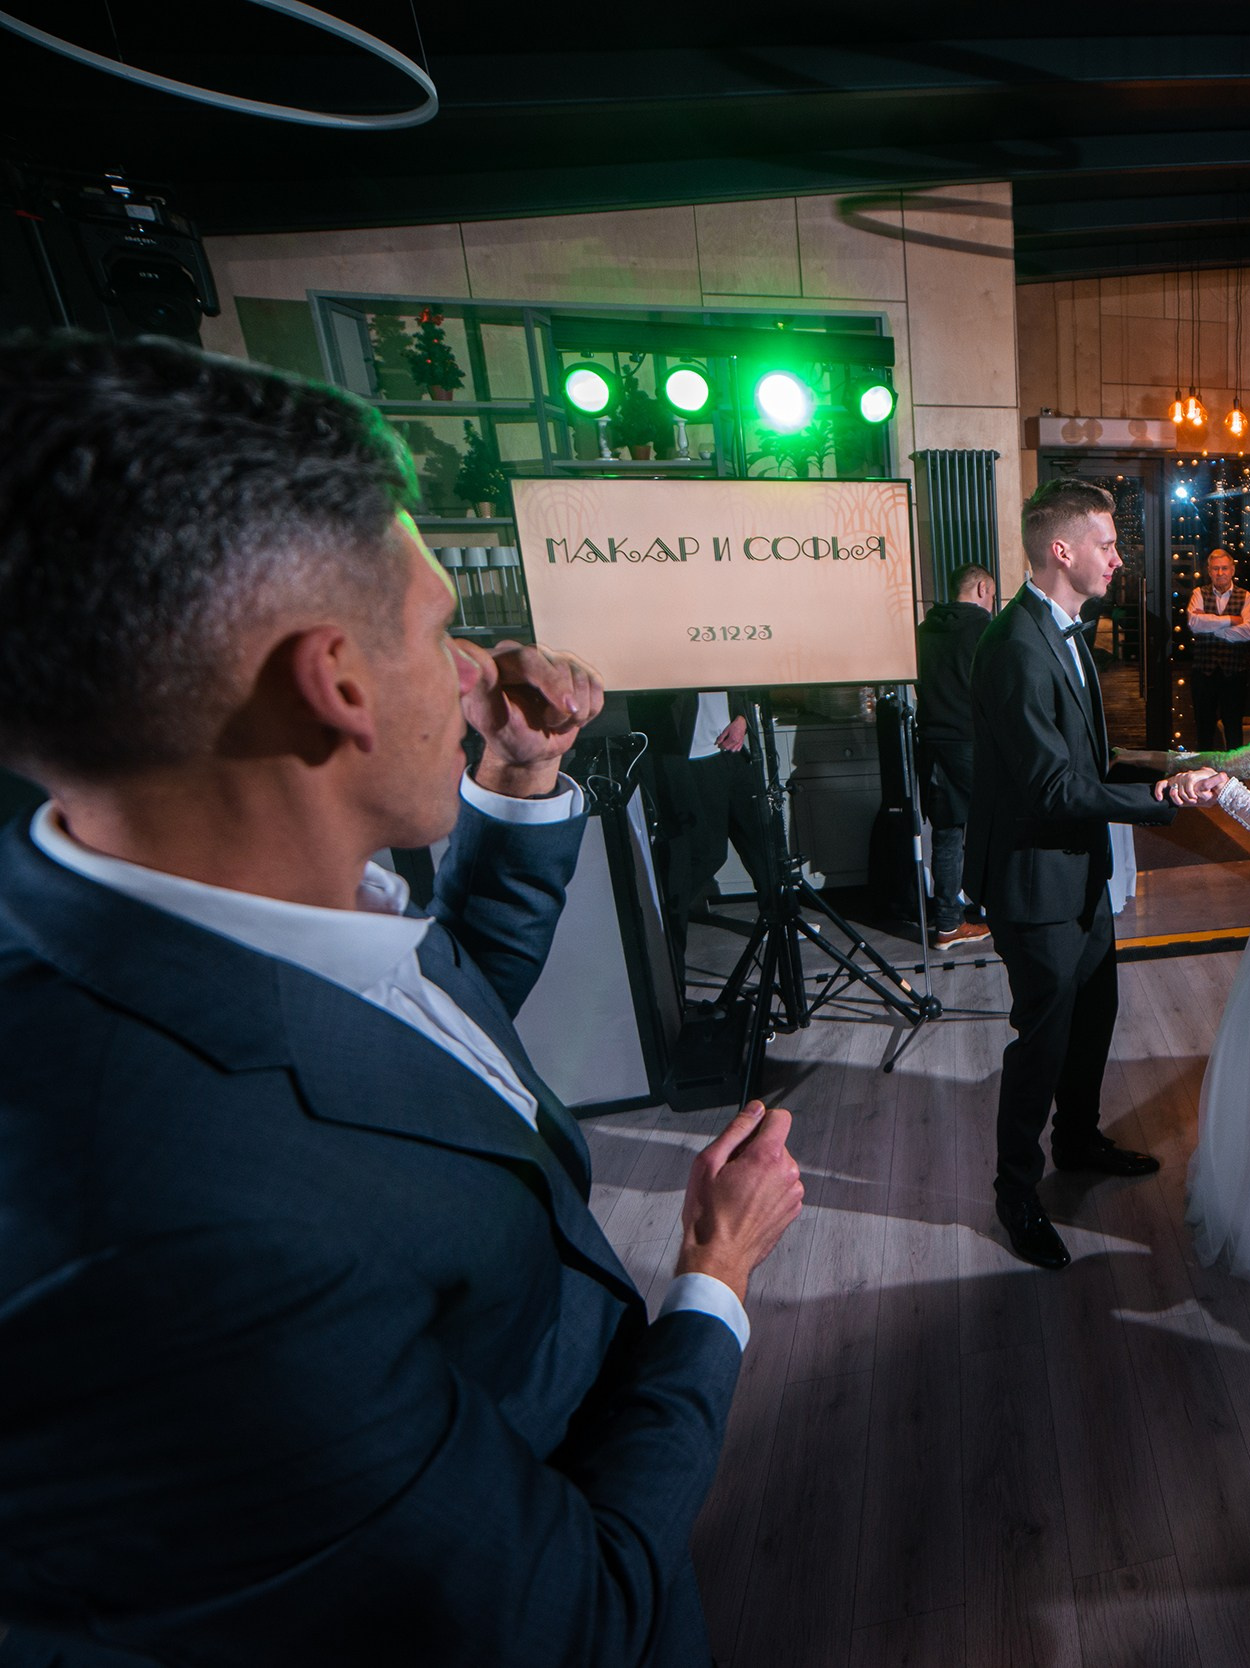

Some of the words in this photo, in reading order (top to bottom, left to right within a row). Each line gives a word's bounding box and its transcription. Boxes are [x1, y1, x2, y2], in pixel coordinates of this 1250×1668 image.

[546, 536, 700, 564] МАКАР
[712, 536, 731, 562] И
[744, 535, 886, 562] СОФЬЯ
[686, 624, 773, 643] 23.12.23
